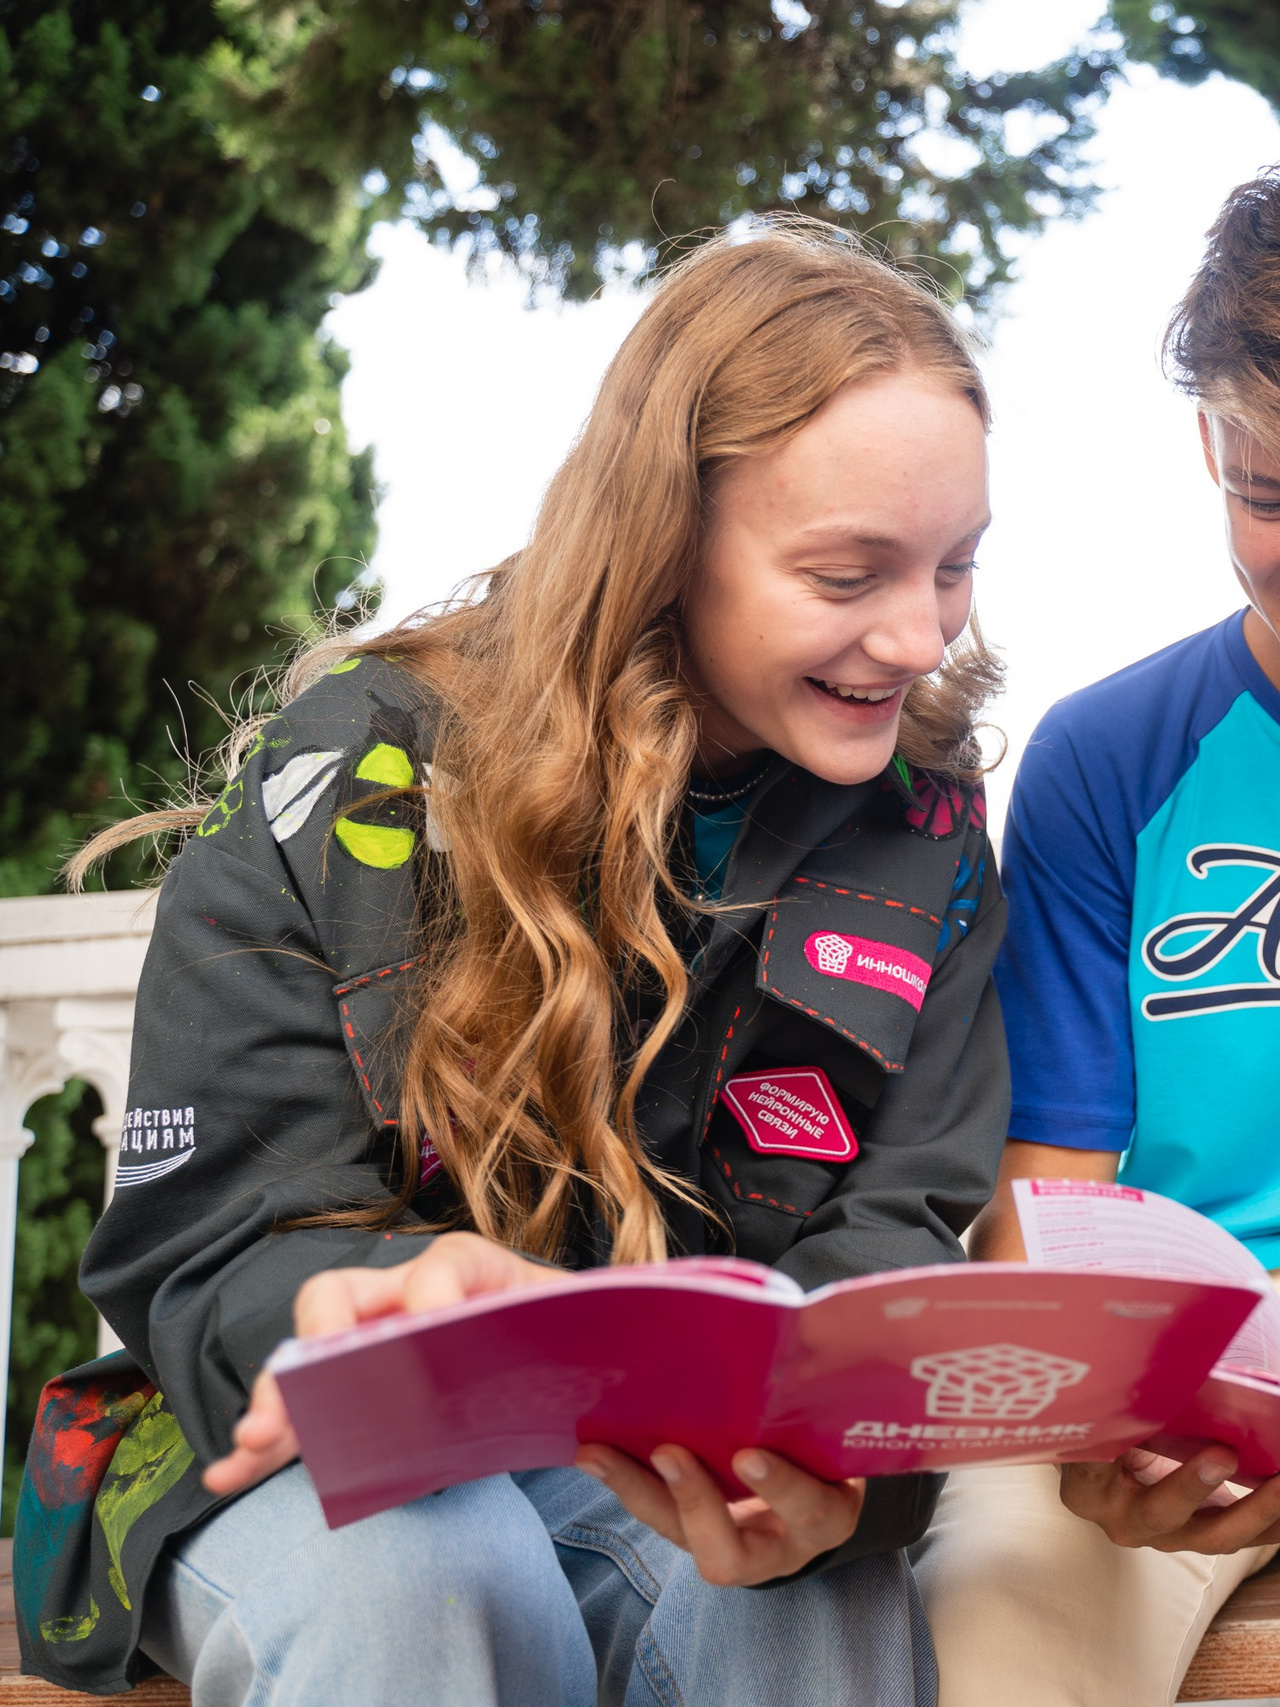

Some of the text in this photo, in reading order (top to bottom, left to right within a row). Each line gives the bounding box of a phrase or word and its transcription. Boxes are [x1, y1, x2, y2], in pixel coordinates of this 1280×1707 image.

[856, 954, 928, 997] ИННОШКОЛ
[747, 1091, 825, 1140] НЕЙРОННЫЕ
[760, 1082, 830, 1126] ФОРМИРУЮ
[120, 1126, 195, 1153] АЦИЯМ
[757, 1109, 799, 1139] СВЯЗИ
[844, 1420, 1096, 1440] ДНЕВНИК
